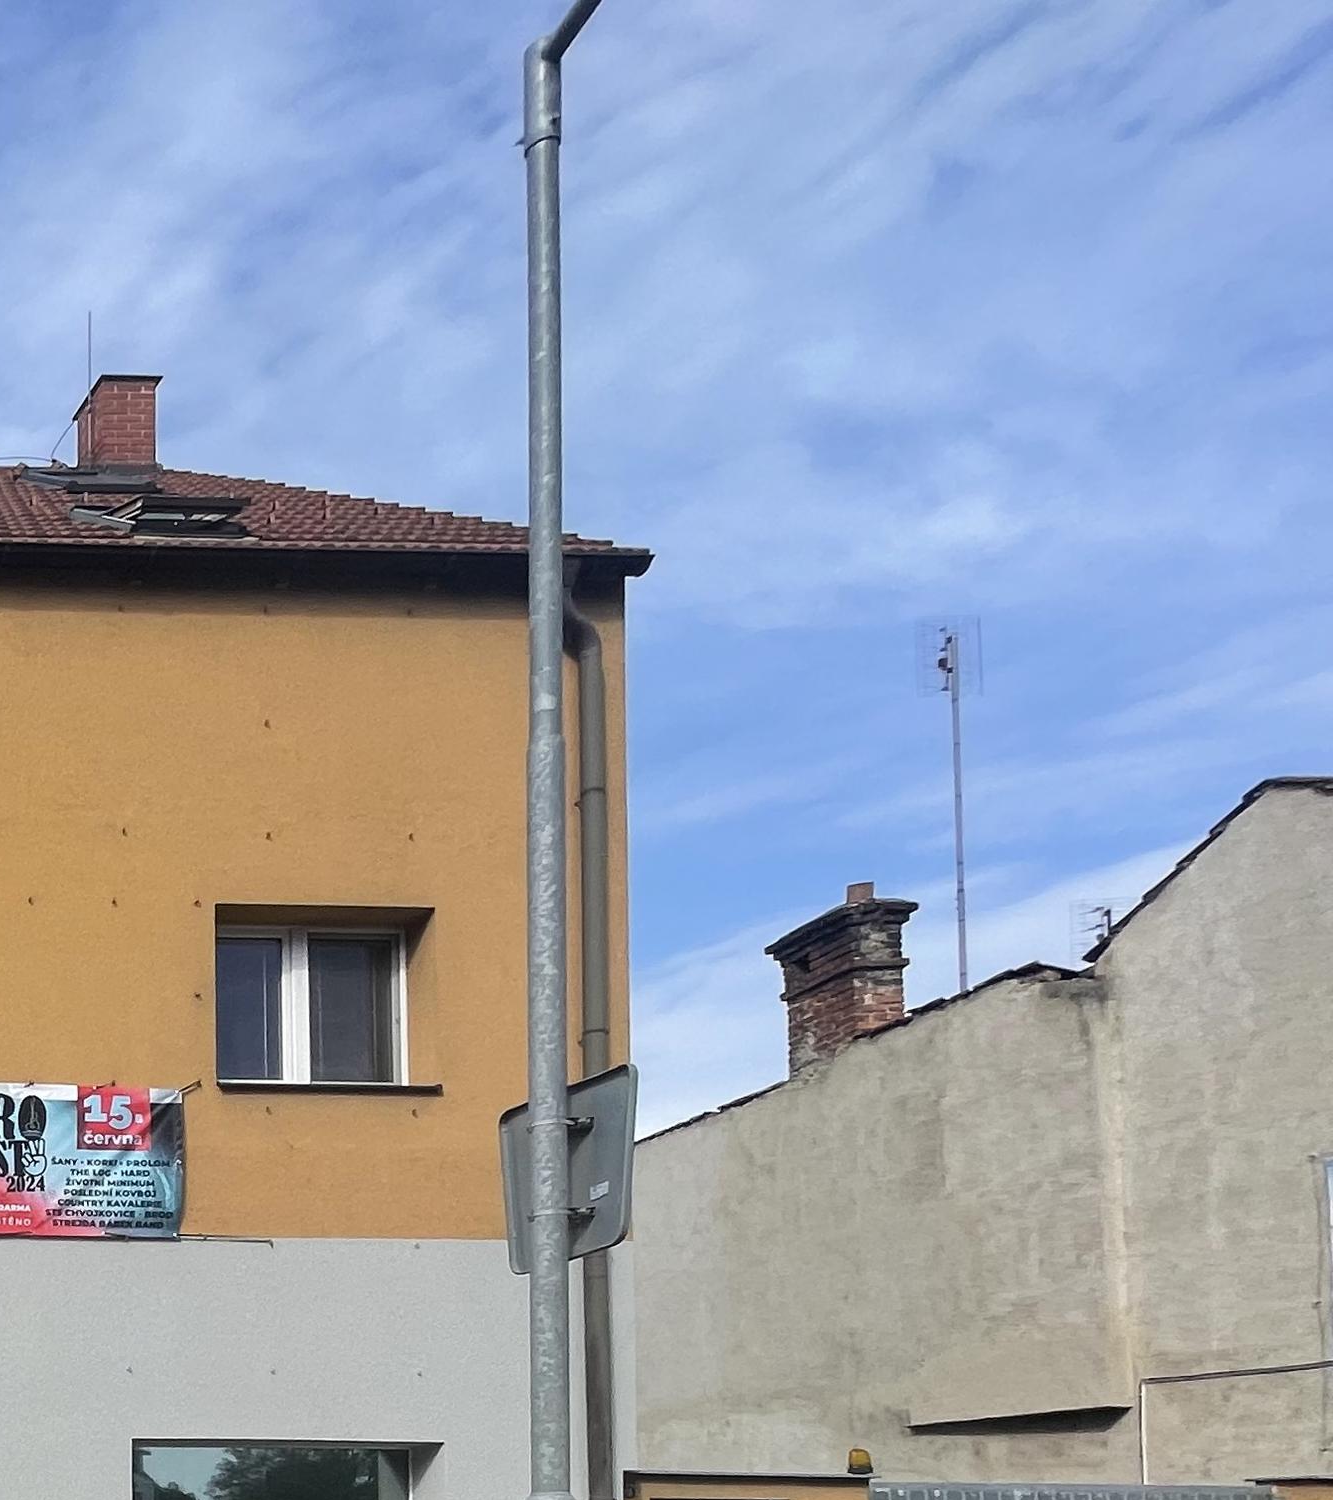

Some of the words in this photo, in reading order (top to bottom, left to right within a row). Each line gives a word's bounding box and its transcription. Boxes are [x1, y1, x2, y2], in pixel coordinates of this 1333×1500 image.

[83, 1130, 142, 1145] června
[70, 1168, 90, 1176] THE
[121, 1169, 150, 1177] HARD
[6, 1175, 45, 1192] 2024
[107, 1179, 155, 1187] MINIMUM
[115, 1190, 156, 1198] KOVBOJ
[57, 1199, 103, 1207] COUNTRY
